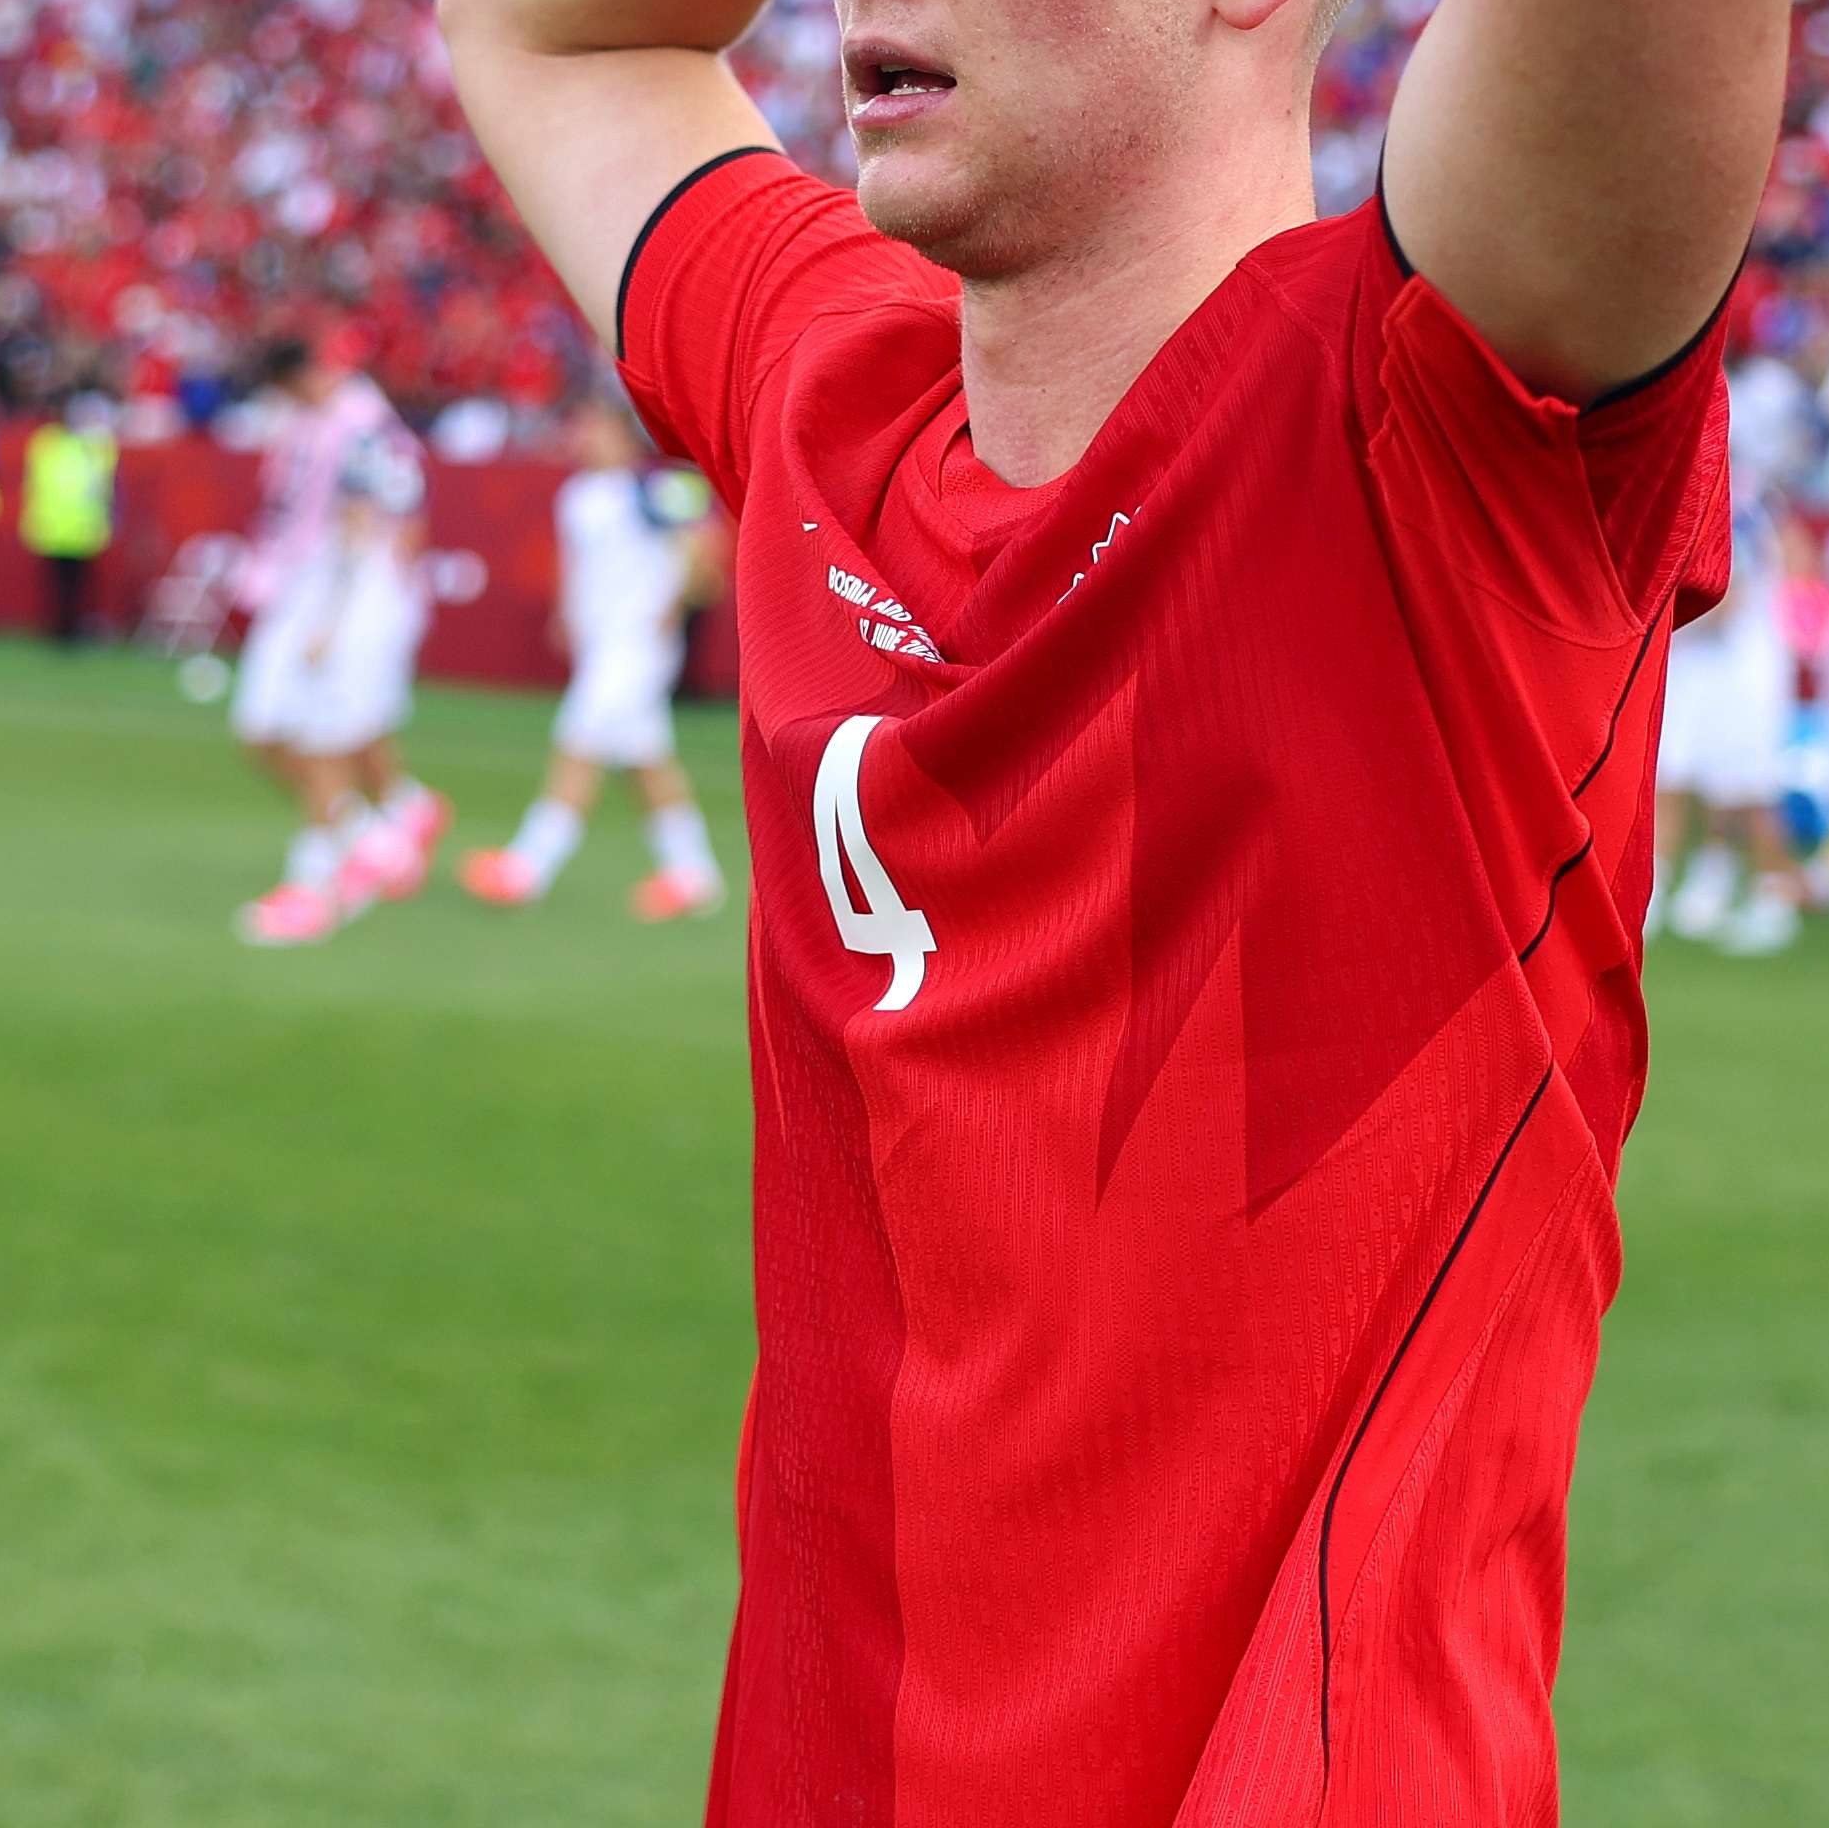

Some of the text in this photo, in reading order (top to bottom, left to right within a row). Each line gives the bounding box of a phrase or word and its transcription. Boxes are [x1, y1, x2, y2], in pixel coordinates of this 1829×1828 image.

[828, 565, 913, 622] BOSNIA AND
[871, 623, 908, 652] JUNE
[813, 714, 938, 1011] 4
